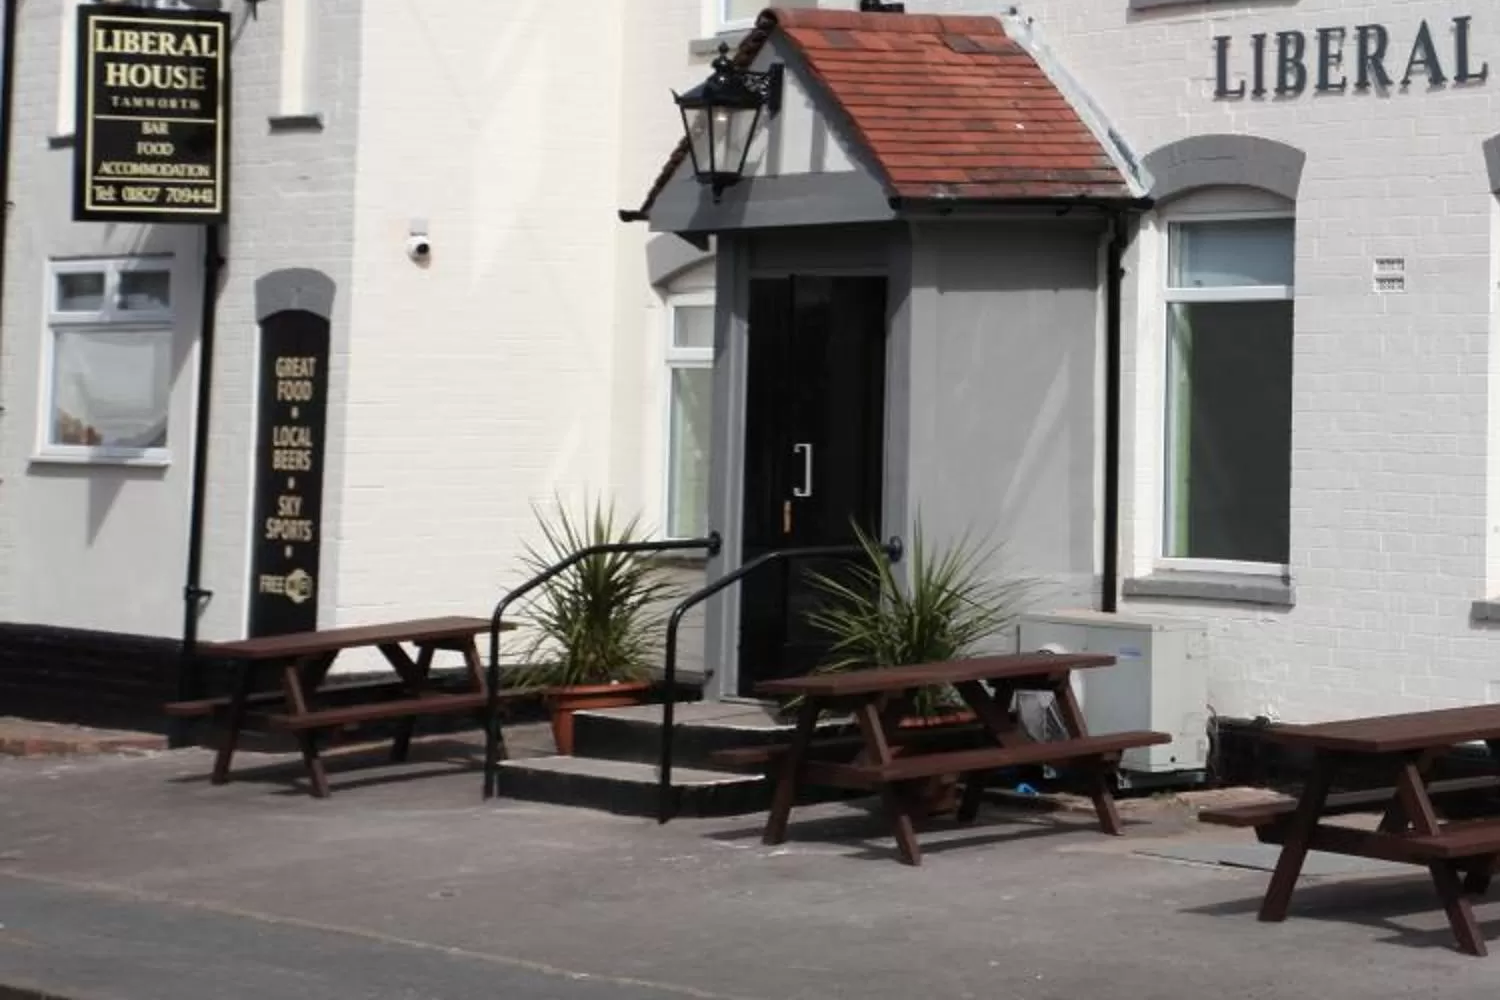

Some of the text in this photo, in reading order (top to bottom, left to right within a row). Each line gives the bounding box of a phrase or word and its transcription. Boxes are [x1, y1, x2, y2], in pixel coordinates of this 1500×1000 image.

[95, 28, 217, 58] LIBERAL
[1213, 15, 1488, 100] LIBERAL
[105, 62, 206, 90] HOUSE
[111, 95, 201, 110] TAMWORTH
[142, 121, 169, 135] BAR
[137, 141, 175, 156] FOOD
[99, 160, 210, 177] ACCOMMODATION
[275, 356, 317, 378] GREAT
[277, 380, 313, 402] FOOD
[272, 425, 313, 447] LOCAL
[272, 449, 312, 471] BEERS
[277, 495, 302, 517] SKY
[265, 518, 313, 541] SPORTS
[259, 574, 283, 594] FREE
